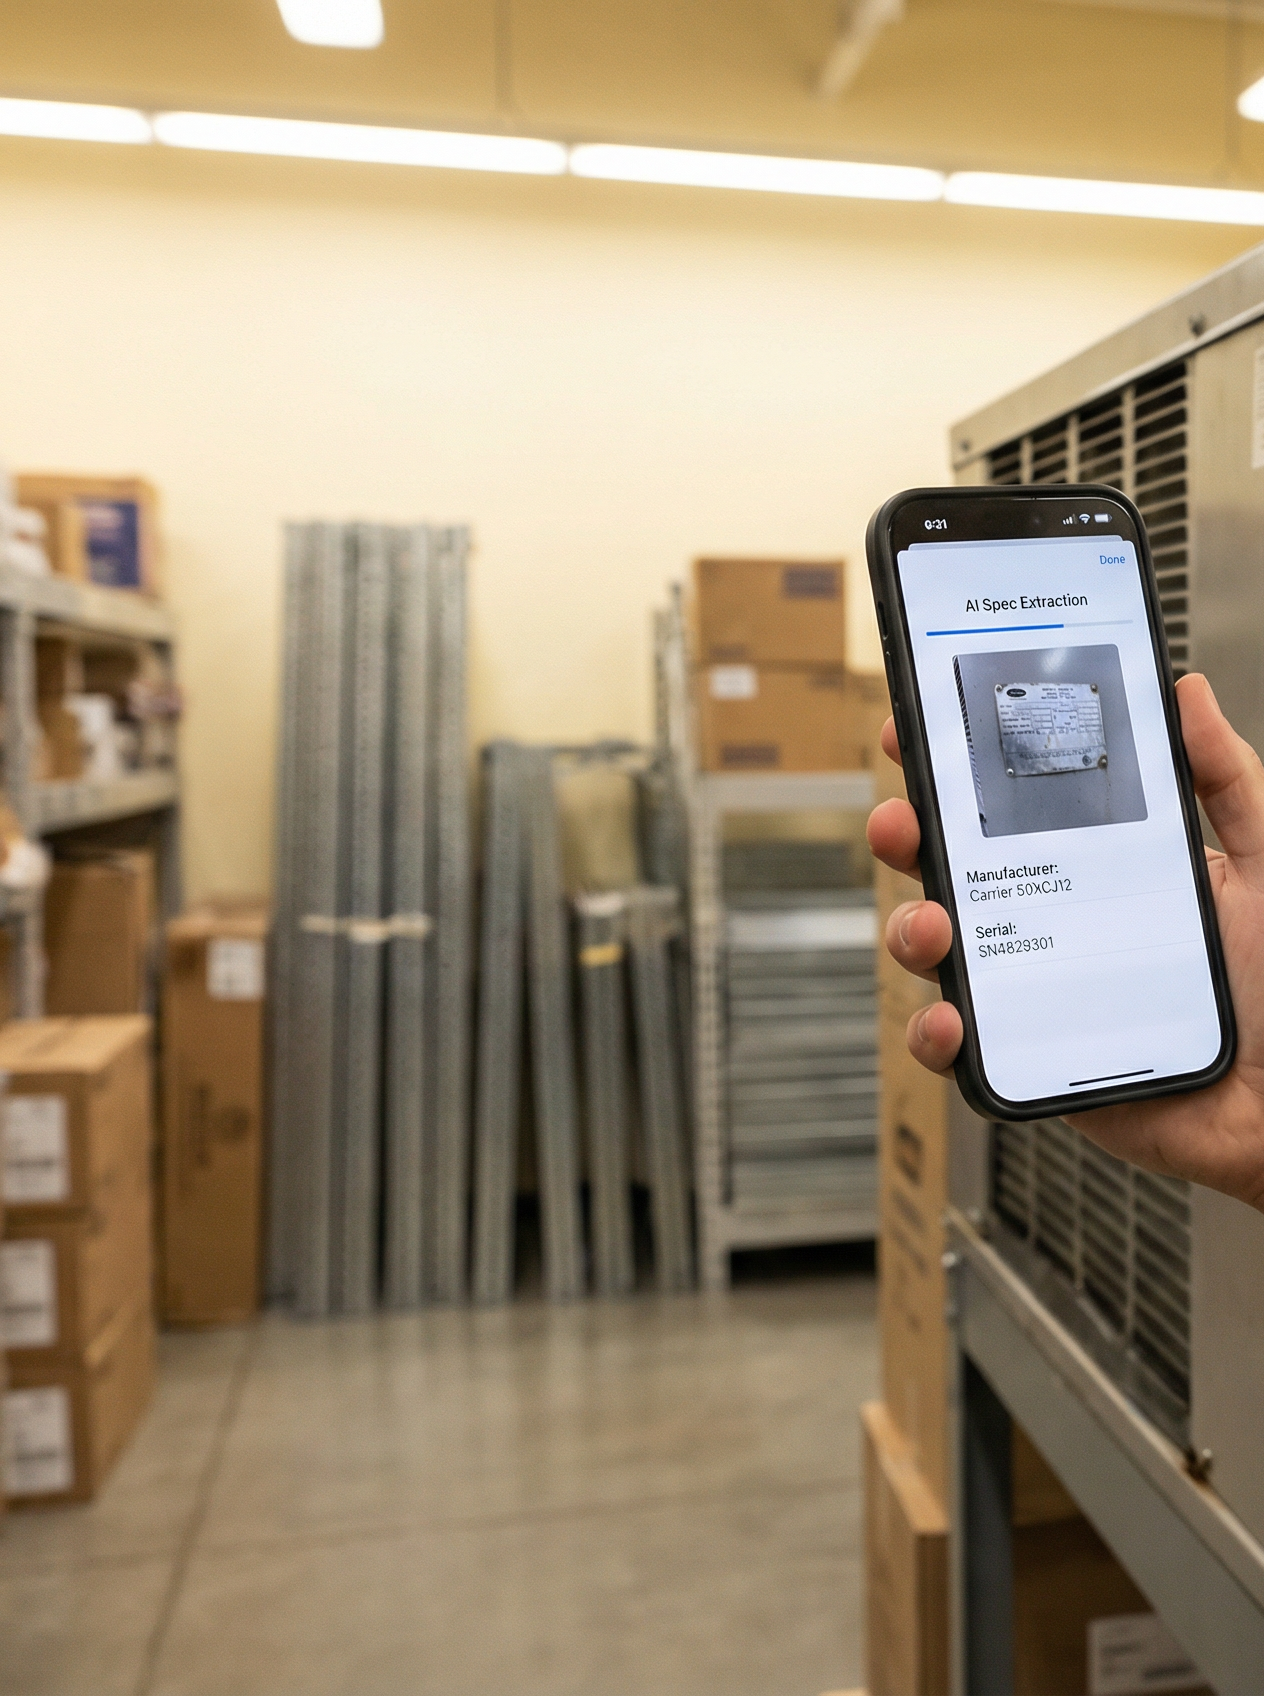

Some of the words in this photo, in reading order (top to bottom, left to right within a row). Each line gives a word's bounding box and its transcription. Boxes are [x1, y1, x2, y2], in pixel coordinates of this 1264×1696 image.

[1099, 554, 1126, 565] Done
[966, 599, 980, 612] AI
[983, 597, 1018, 613] Spec
[1020, 593, 1089, 609] Extraction
[966, 864, 1059, 883] Manufacturer:
[970, 886, 1012, 902] Carrier
[1016, 878, 1072, 897] 50XCJ12
[975, 922, 1017, 939] Serial:
[978, 936, 1054, 958] SN4829301
